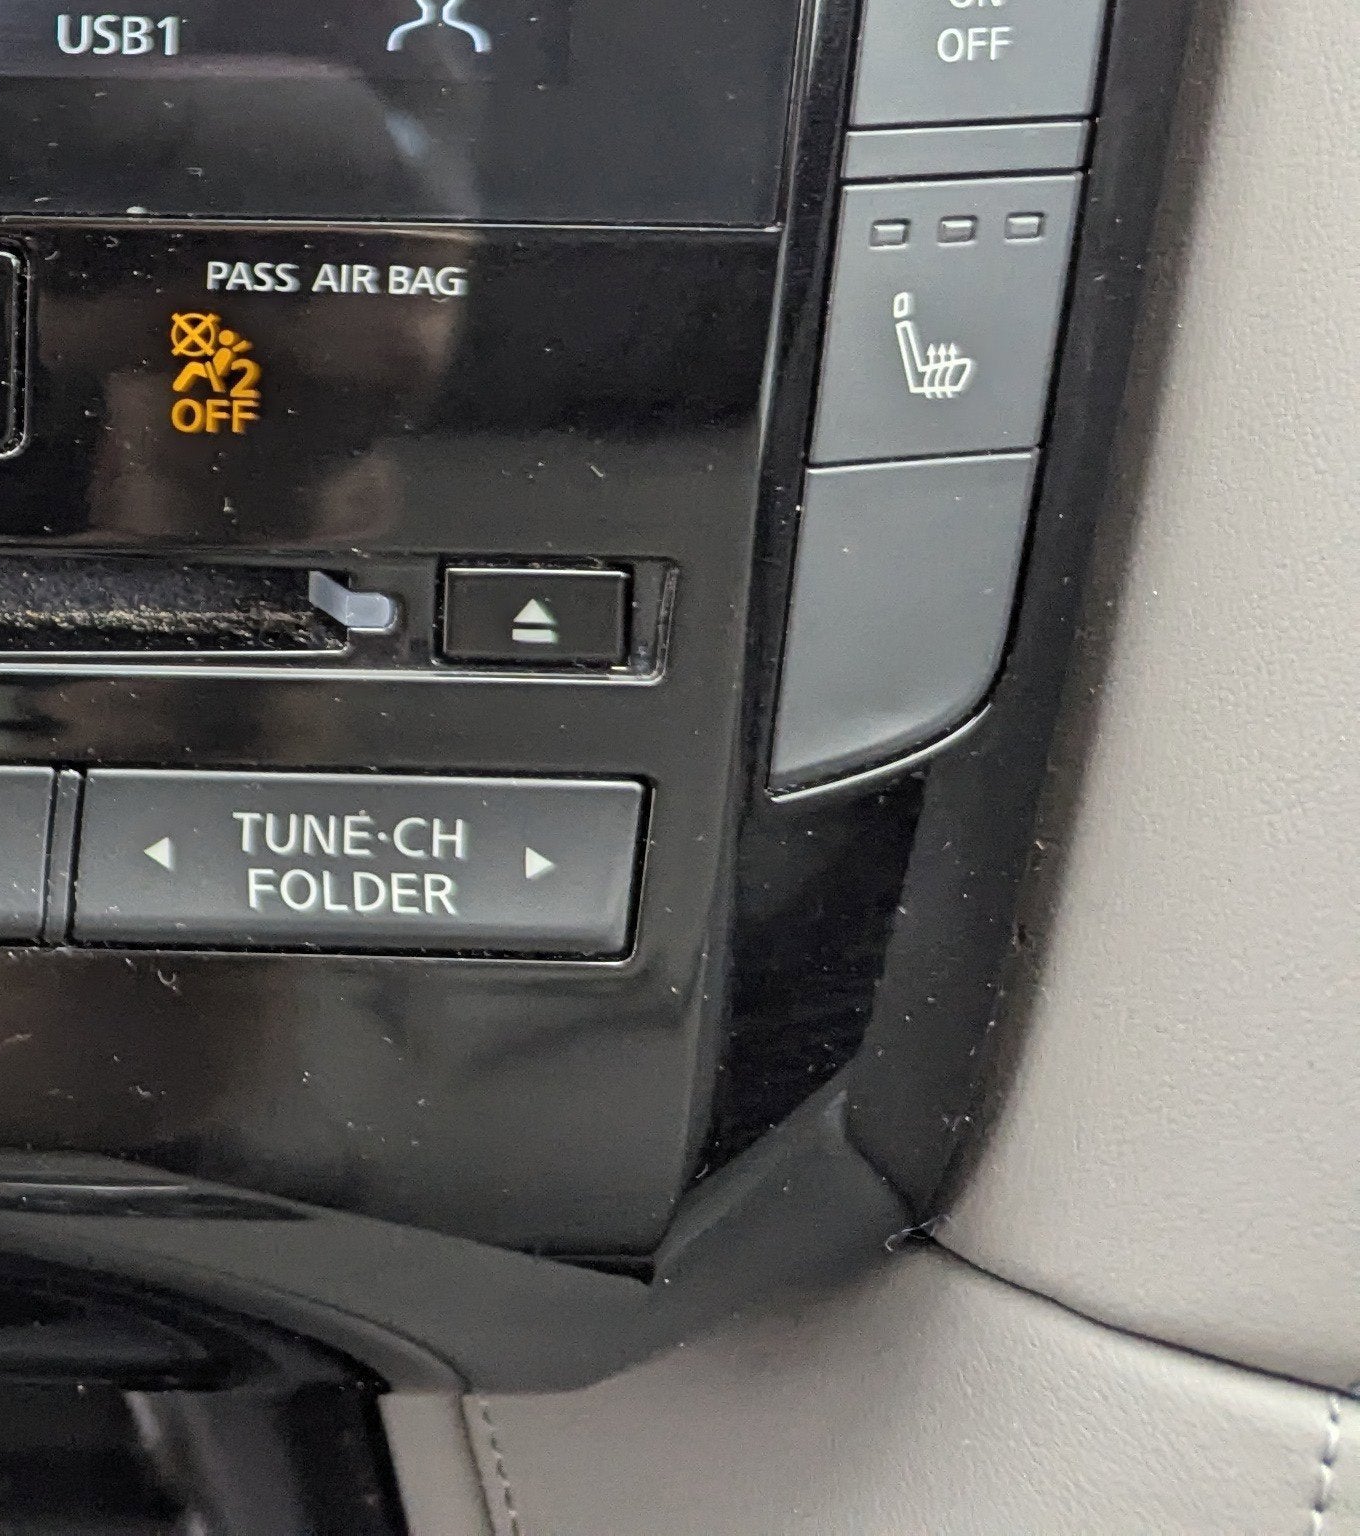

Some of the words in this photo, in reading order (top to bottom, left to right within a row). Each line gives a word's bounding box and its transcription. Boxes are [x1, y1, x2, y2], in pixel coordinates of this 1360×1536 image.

[57, 14, 180, 56] USB1
[936, 26, 1014, 63] OFF
[206, 261, 300, 293] PASS
[311, 264, 380, 295] AIR
[387, 265, 470, 297] BAG
[170, 398, 261, 434] OFF
[247, 868, 460, 917] FOLDER
